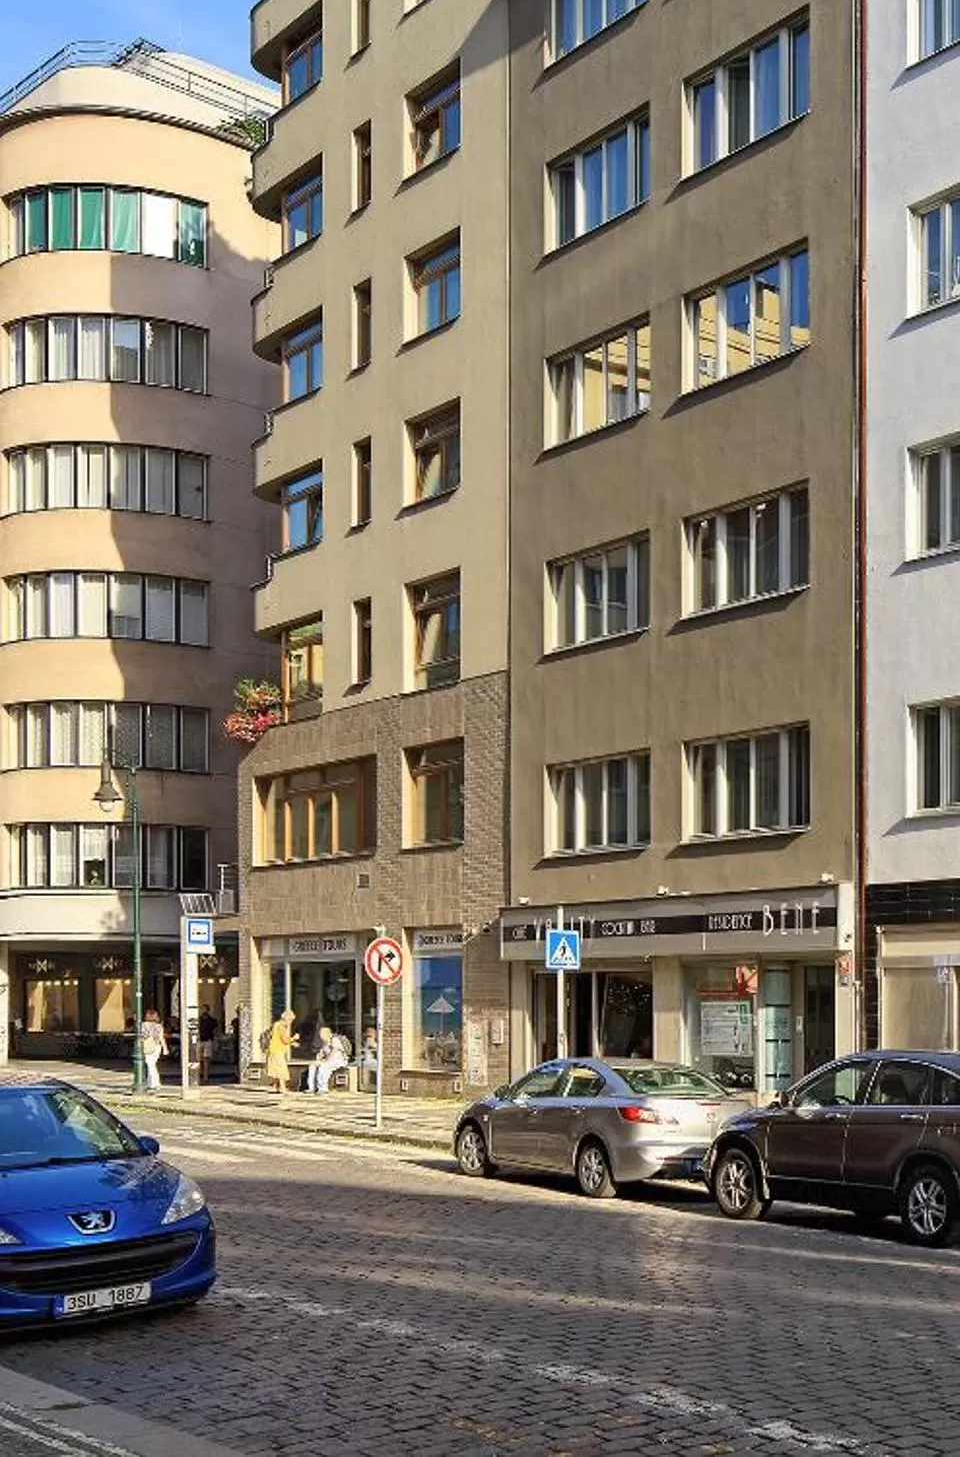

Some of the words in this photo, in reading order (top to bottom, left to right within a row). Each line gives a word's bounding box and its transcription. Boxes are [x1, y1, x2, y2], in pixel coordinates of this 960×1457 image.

[762, 901, 820, 936] BENE
[67, 1293, 97, 1310] 3SU
[108, 1285, 145, 1303] 1887
